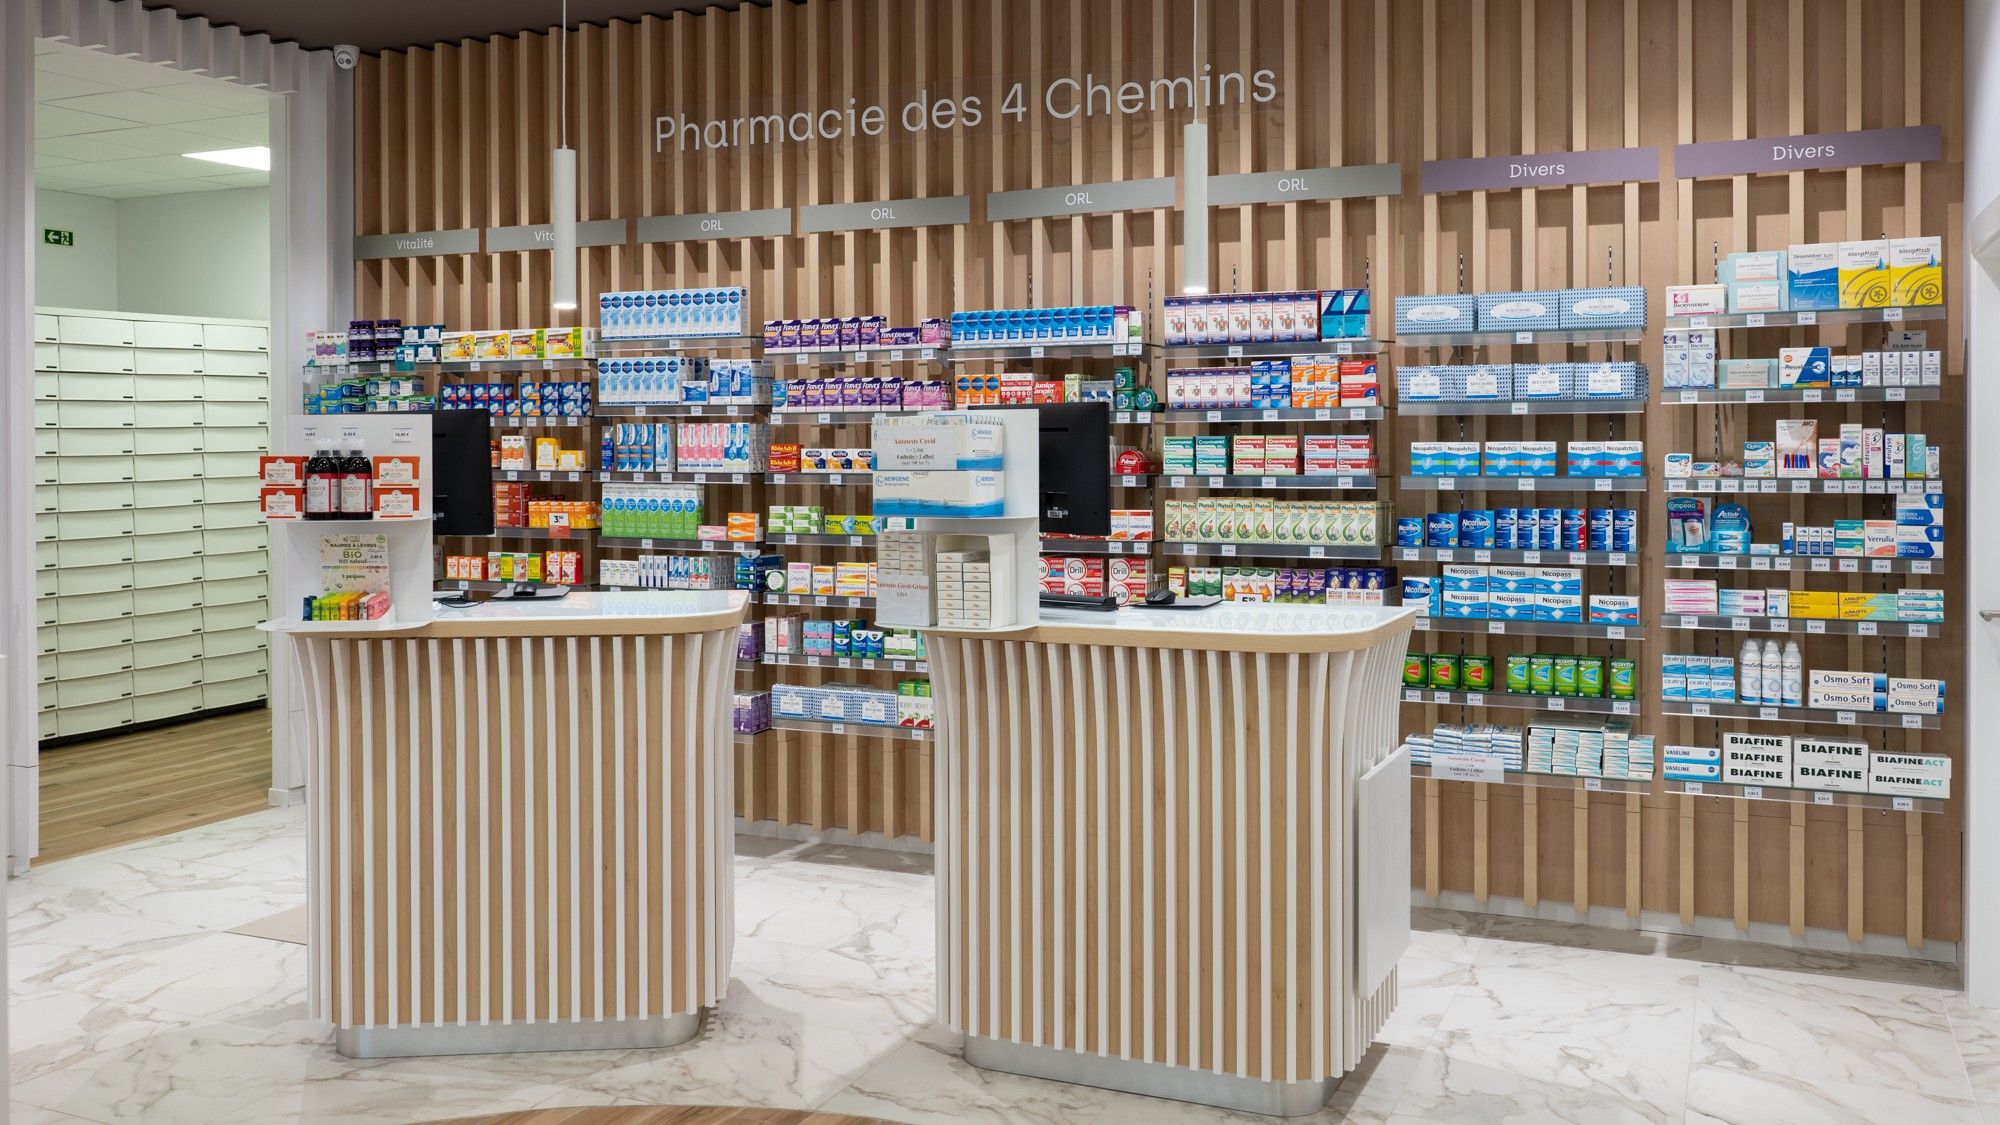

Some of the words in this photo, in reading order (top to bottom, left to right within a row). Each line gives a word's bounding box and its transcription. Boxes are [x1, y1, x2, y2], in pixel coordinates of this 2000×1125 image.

[656, 97, 886, 153] Pharmacie
[902, 89, 982, 132] des
[1000, 82, 1027, 122] 4
[1045, 63, 1276, 120] Chemins
[1772, 144, 1845, 161] Divers
[1509, 163, 1565, 178] Divers
[1277, 177, 1309, 192] ORL
[1065, 192, 1093, 206] ORL
[870, 207, 896, 220] ORL
[700, 219, 724, 232] ORL
[396, 237, 434, 250] Vitalité
[1450, 568, 1479, 576] Nicopass
[1497, 569, 1526, 577] Nicopass
[1542, 569, 1572, 578] Nicopass
[1451, 594, 1479, 602] Nicopass
[1497, 595, 1525, 603] Nicopass
[1542, 596, 1572, 604] Nicopass
[1599, 599, 1629, 607] Nicopass
[1824, 675, 1848, 684] Osmo
[1851, 676, 1870, 685] Soft
[1897, 681, 1918, 690] Osmo
[1920, 683, 1936, 691] Soft
[1824, 694, 1848, 703] Osmo
[1851, 695, 1870, 704] Soft
[1895, 699, 1916, 707] Osmo
[1918, 700, 1935, 708] Soft
[1730, 736, 1783, 747] BIAFINE
[1665, 749, 1690, 757] VASELINE
[1800, 744, 1862, 756] BIAFINE
[1730, 751, 1783, 763] BIAFINE
[1665, 765, 1690, 773] VASELINE
[1730, 767, 1783, 779] BIAFINE
[1800, 767, 1862, 780] BIAFINE
